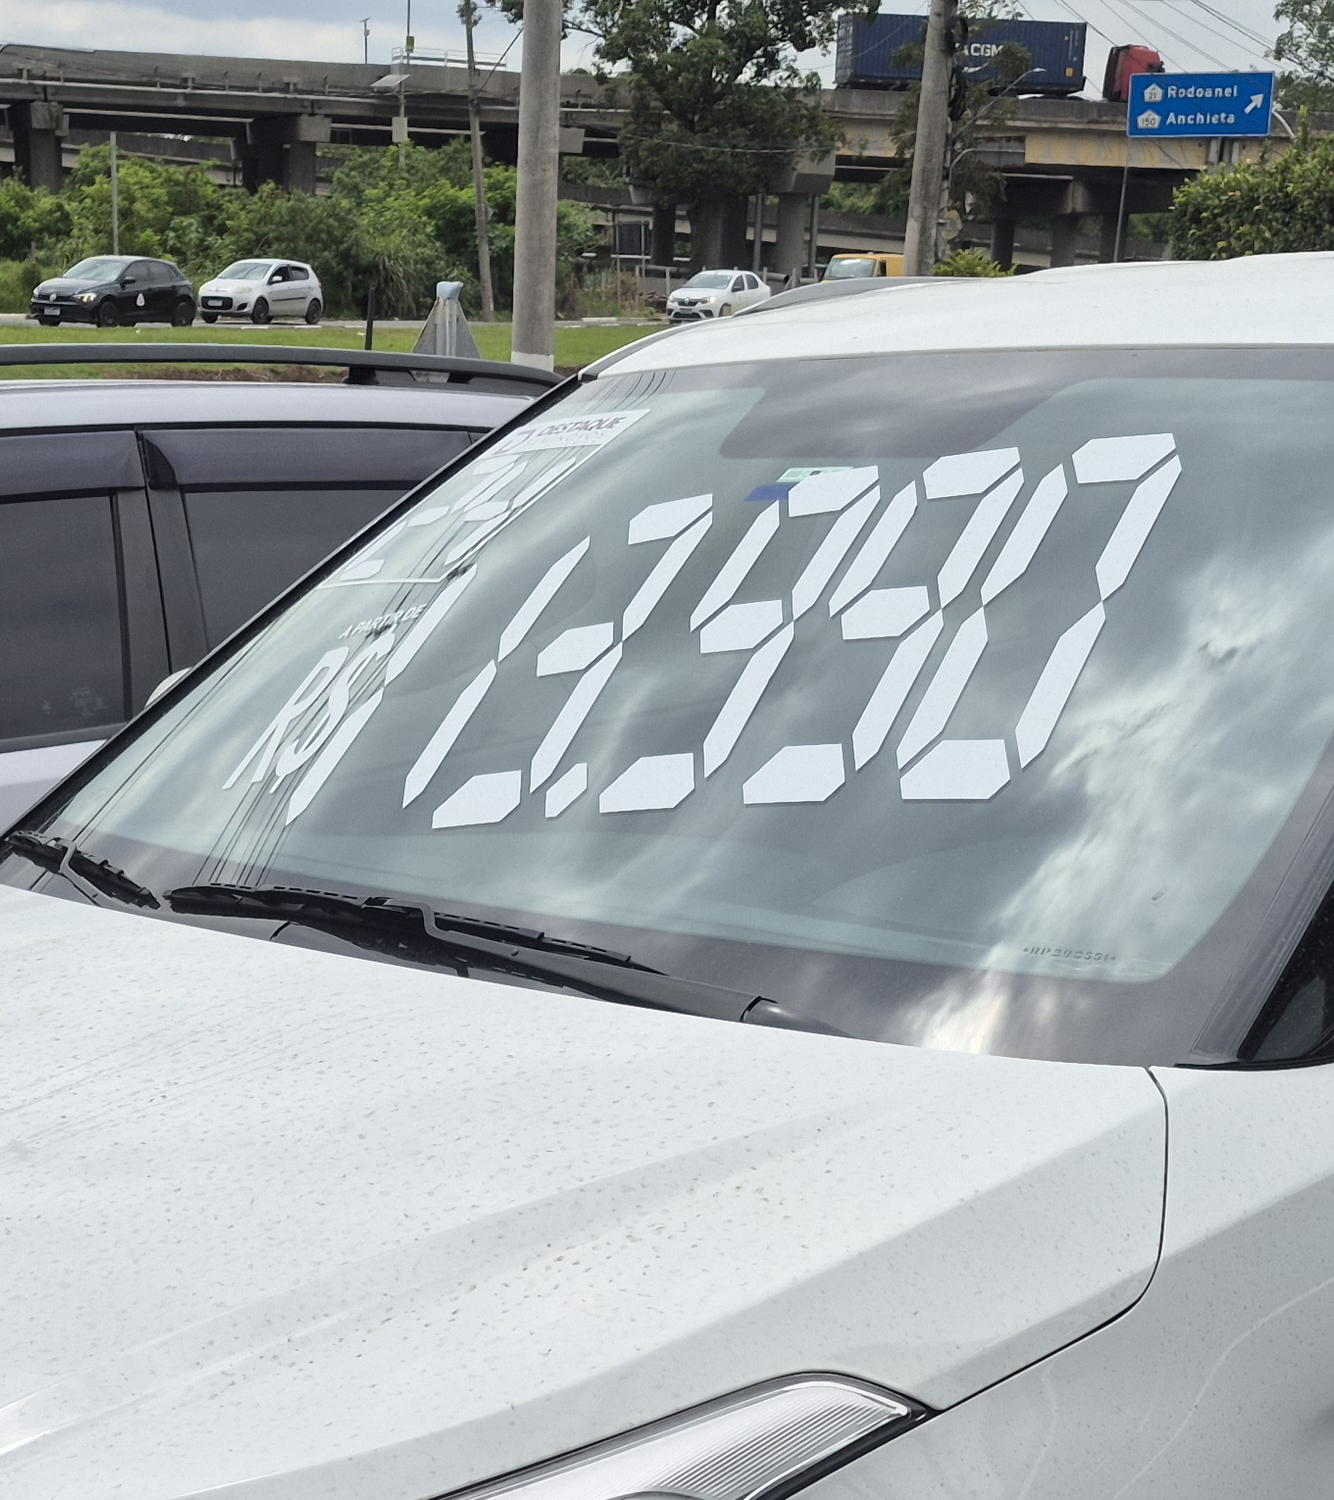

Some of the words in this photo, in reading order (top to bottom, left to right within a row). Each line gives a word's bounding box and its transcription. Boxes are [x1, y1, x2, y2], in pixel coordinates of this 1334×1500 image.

[970, 42, 1004, 57] CGM
[1167, 85, 1238, 98] Rodoanel
[1141, 118, 1156, 126] 150
[1166, 112, 1236, 125] Anchieta
[536, 416, 627, 437] DESTAQUE
[351, 609, 405, 636] PARTIR
[401, 603, 428, 621] DE
[223, 623, 397, 793] R$
